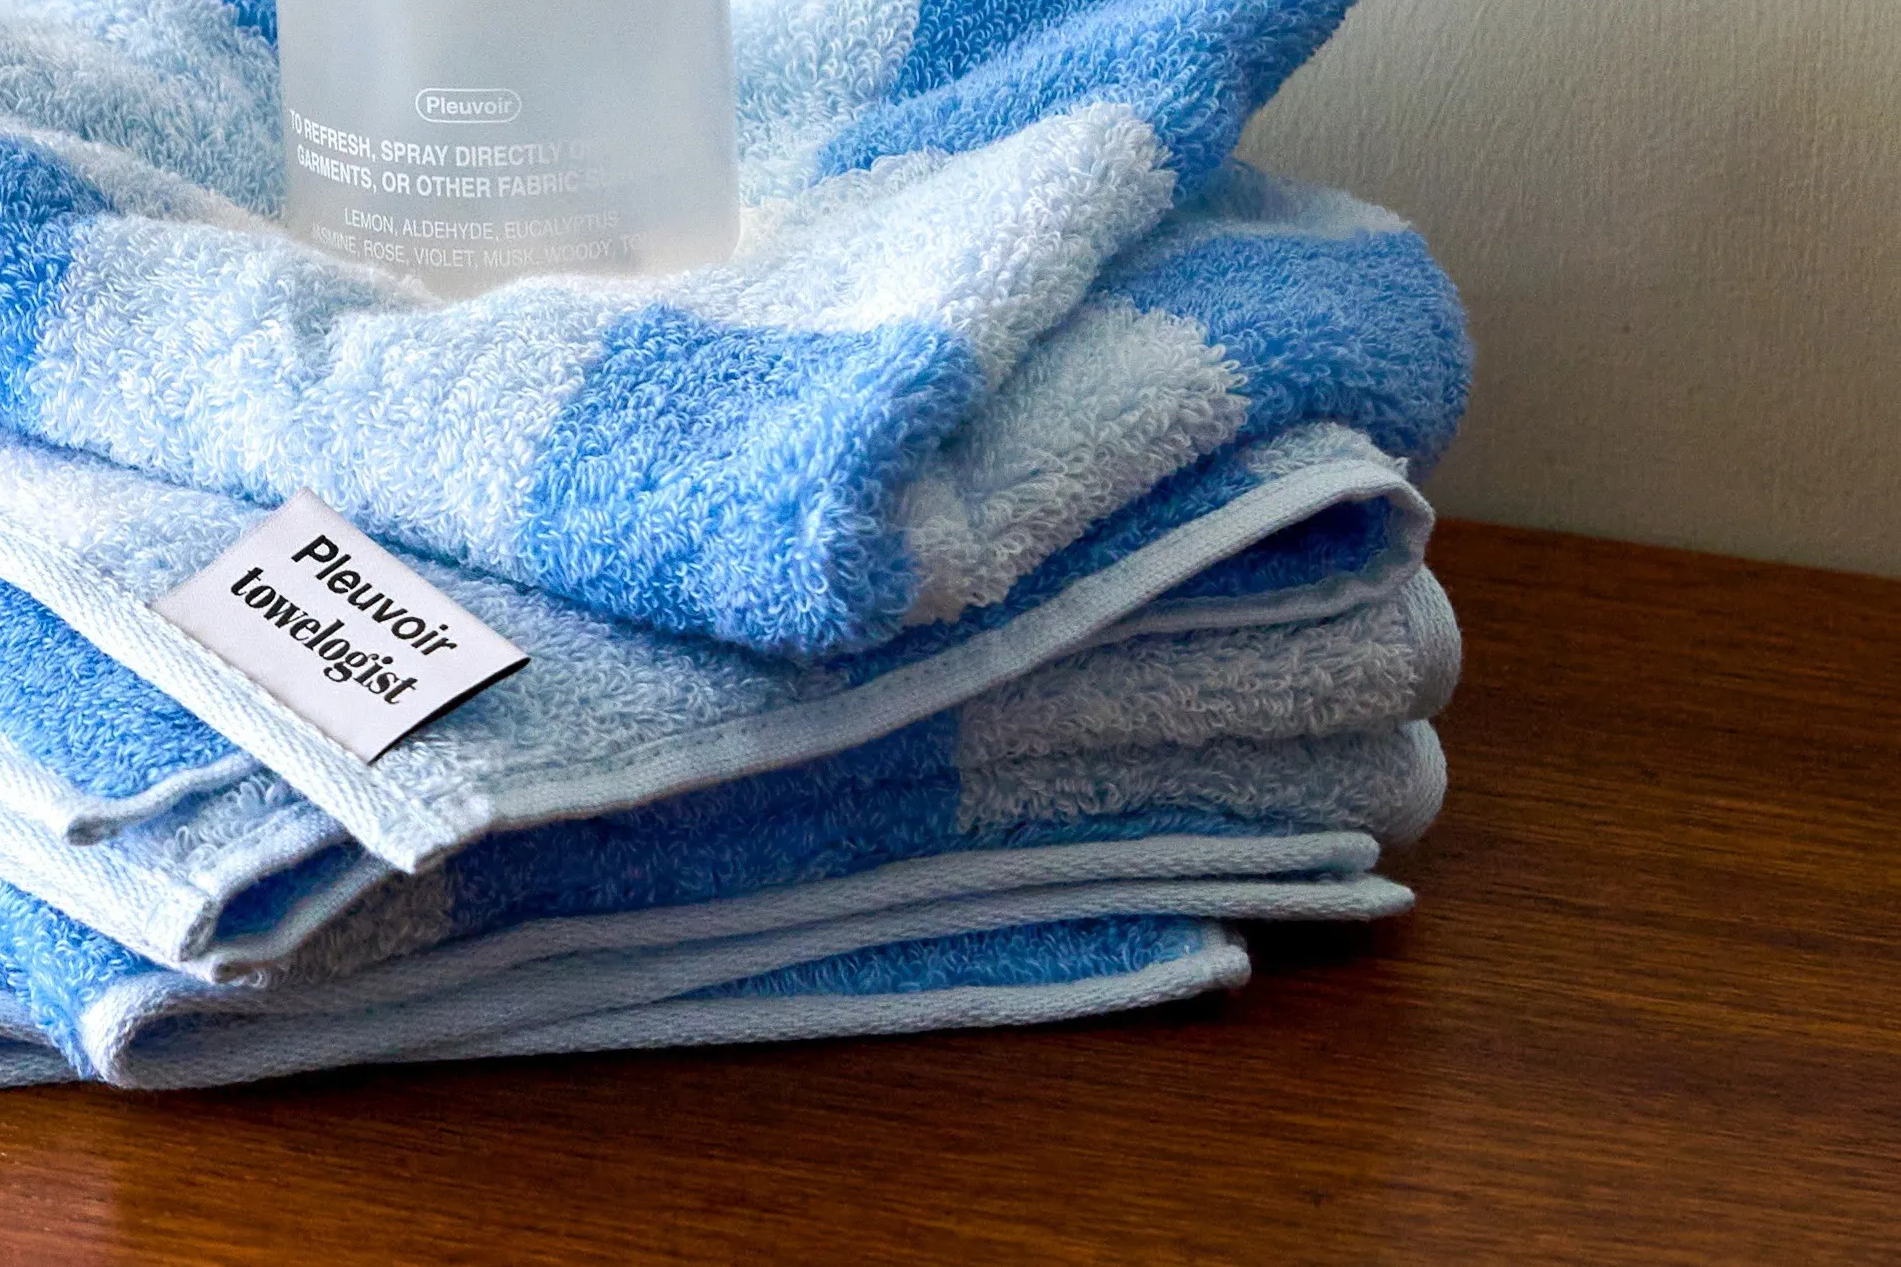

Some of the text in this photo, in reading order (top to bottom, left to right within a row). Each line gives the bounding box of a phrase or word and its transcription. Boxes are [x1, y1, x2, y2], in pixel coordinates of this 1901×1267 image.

[426, 95, 512, 116] Pleuvoir
[289, 108, 303, 135] TO
[304, 117, 377, 163] REFRESH,
[381, 139, 448, 167] SPRAY
[455, 138, 562, 168] DIRECTLY
[297, 143, 377, 196] GARMENTS,
[382, 170, 411, 196] OR
[417, 174, 491, 199] OTHER
[499, 169, 579, 198] FABRIC
[344, 207, 620, 244] LEMON, ALDEHYDE, EUCALYPTUS
[363, 239, 410, 266] ROSE,
[291, 534, 459, 656] Pleuvoir
[230, 566, 419, 705] towelogist
